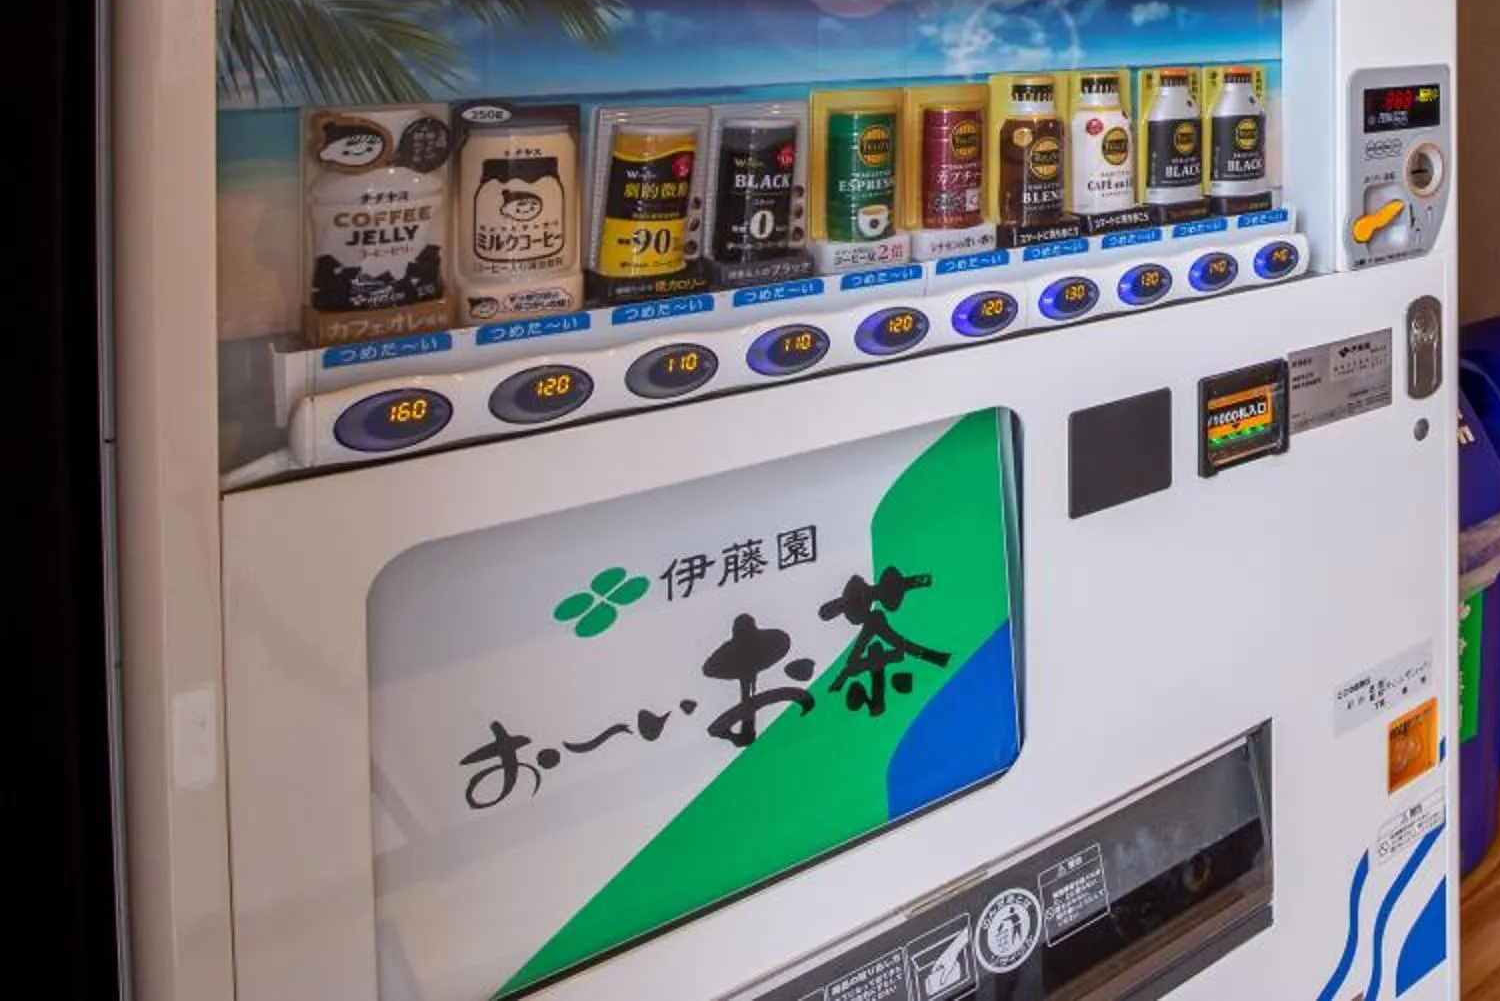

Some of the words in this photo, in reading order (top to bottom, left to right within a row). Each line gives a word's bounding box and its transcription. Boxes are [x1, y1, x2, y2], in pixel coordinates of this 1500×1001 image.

[735, 174, 790, 189] BLACK
[333, 205, 432, 229] COFFEE
[345, 225, 419, 247] JELLY
[477, 228, 562, 252] ミルクコーヒー
[1064, 284, 1086, 301] 130
[982, 300, 1003, 316] 120
[889, 315, 913, 332] 120
[784, 334, 811, 352] 110
[666, 353, 698, 373] 110
[534, 374, 570, 396] 120
[389, 399, 428, 422] 160
[659, 524, 818, 601] 伊藤園
